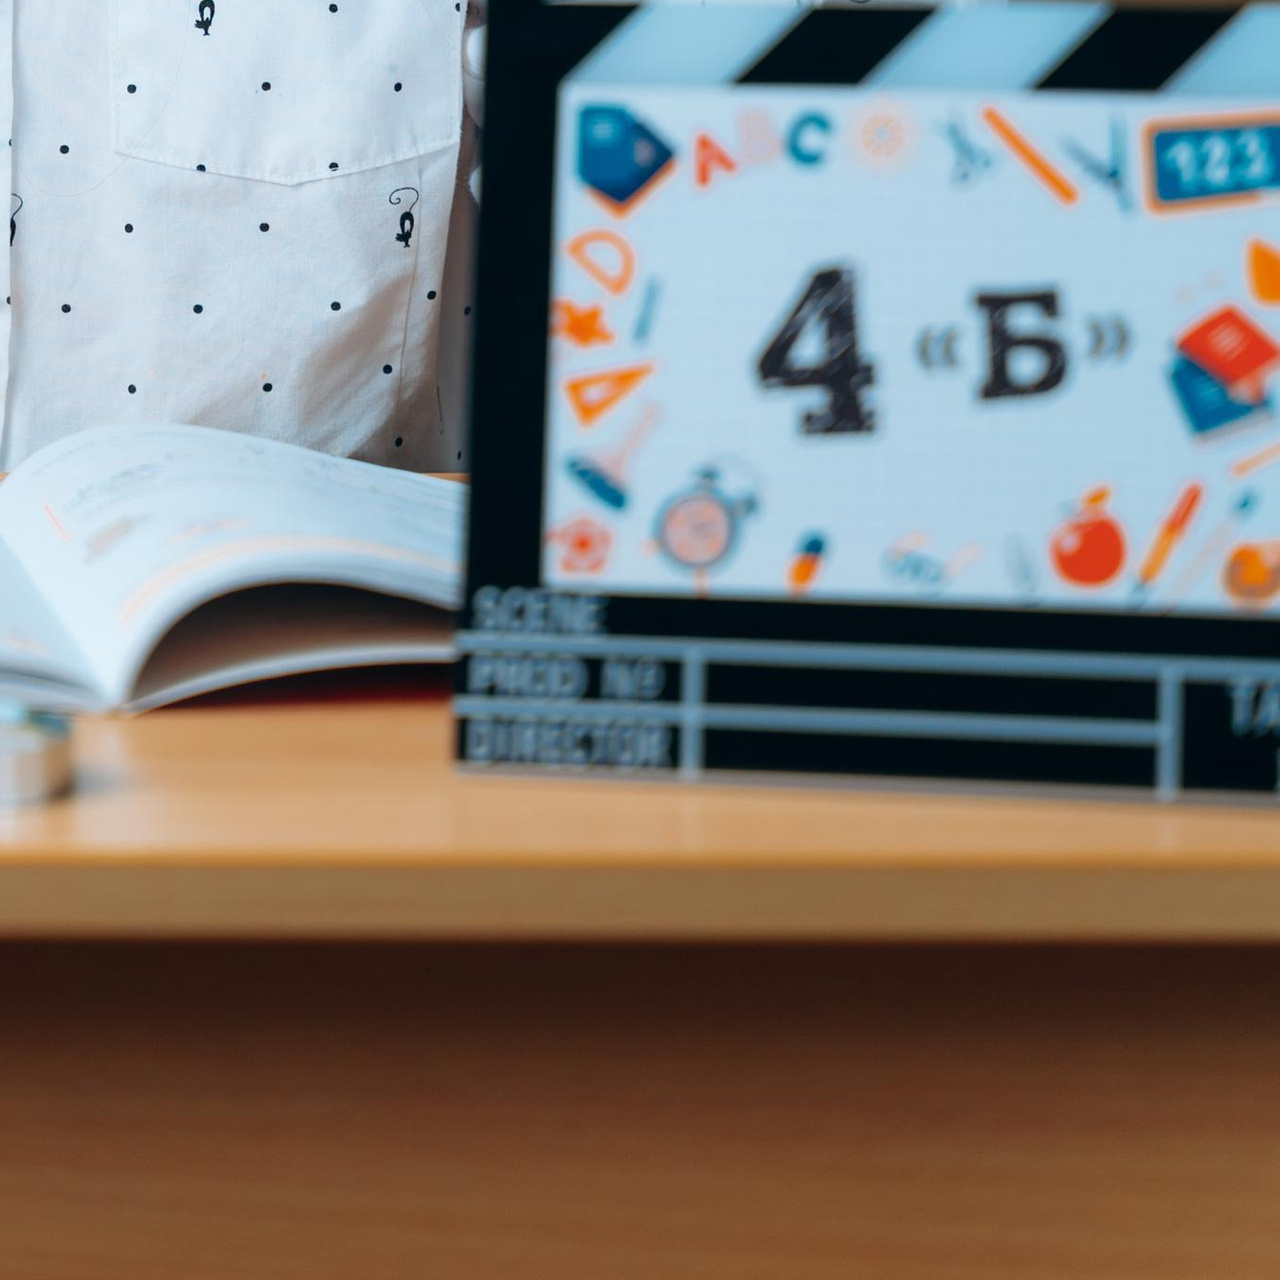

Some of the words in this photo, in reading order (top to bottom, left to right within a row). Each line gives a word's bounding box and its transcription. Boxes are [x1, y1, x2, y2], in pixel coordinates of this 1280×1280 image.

[1164, 131, 1270, 186] 123
[757, 266, 875, 434] 4
[472, 586, 608, 634] SCENE
[468, 720, 671, 768] DIRECTOR
